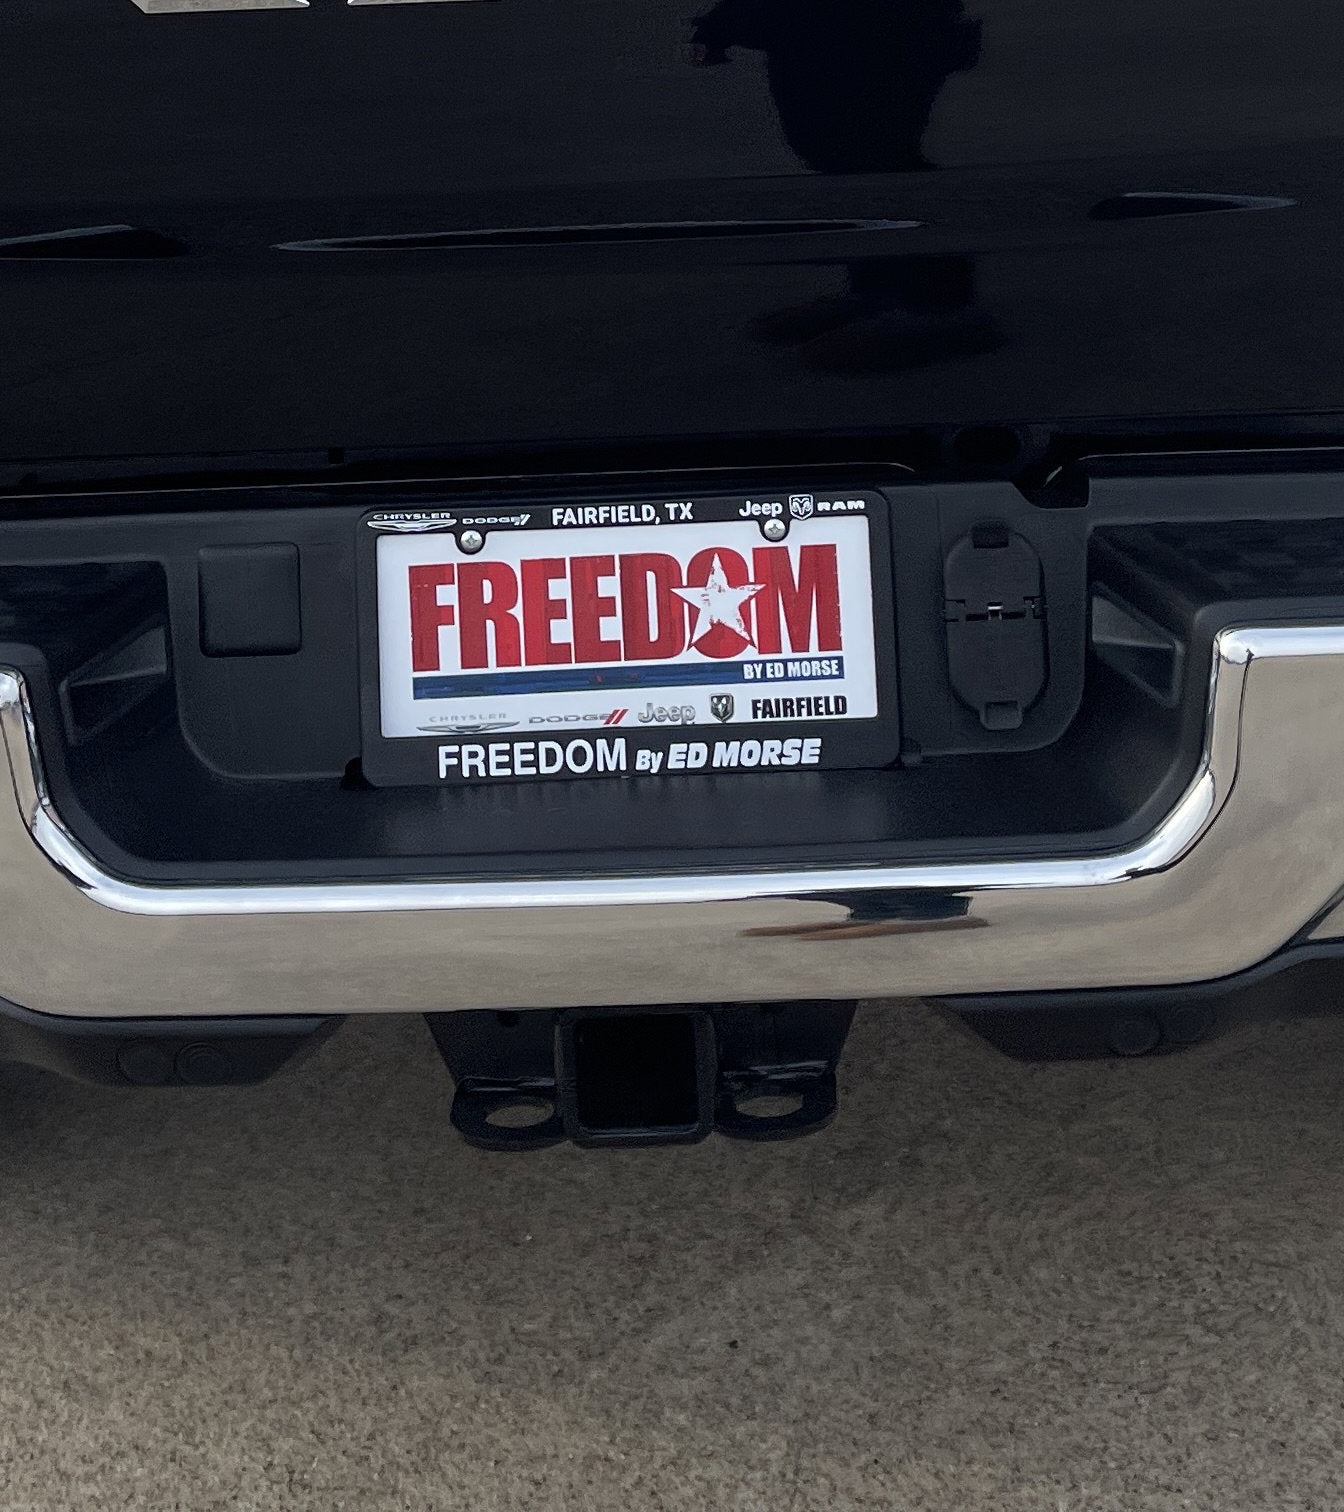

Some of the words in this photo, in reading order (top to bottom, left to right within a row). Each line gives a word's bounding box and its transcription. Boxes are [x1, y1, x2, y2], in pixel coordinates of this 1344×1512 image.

[372, 512, 451, 520] CHRYSLER
[462, 516, 521, 525] DODGE
[552, 504, 661, 526] FAIRFIELD,
[665, 503, 693, 522] TX
[739, 500, 782, 518] Jeep
[817, 500, 865, 512] RAM
[408, 543, 842, 672] FREEDOM
[743, 662, 763, 679] BY
[765, 661, 785, 678] ED
[787, 659, 839, 677] MORSE
[428, 713, 507, 723] CHRYSLER
[638, 703, 696, 724] Jeep
[751, 695, 847, 719] FAIRFIELD
[438, 739, 626, 779] FREEDOM
[635, 750, 662, 772] By
[667, 742, 707, 768] ED
[712, 738, 822, 766] MORSE
